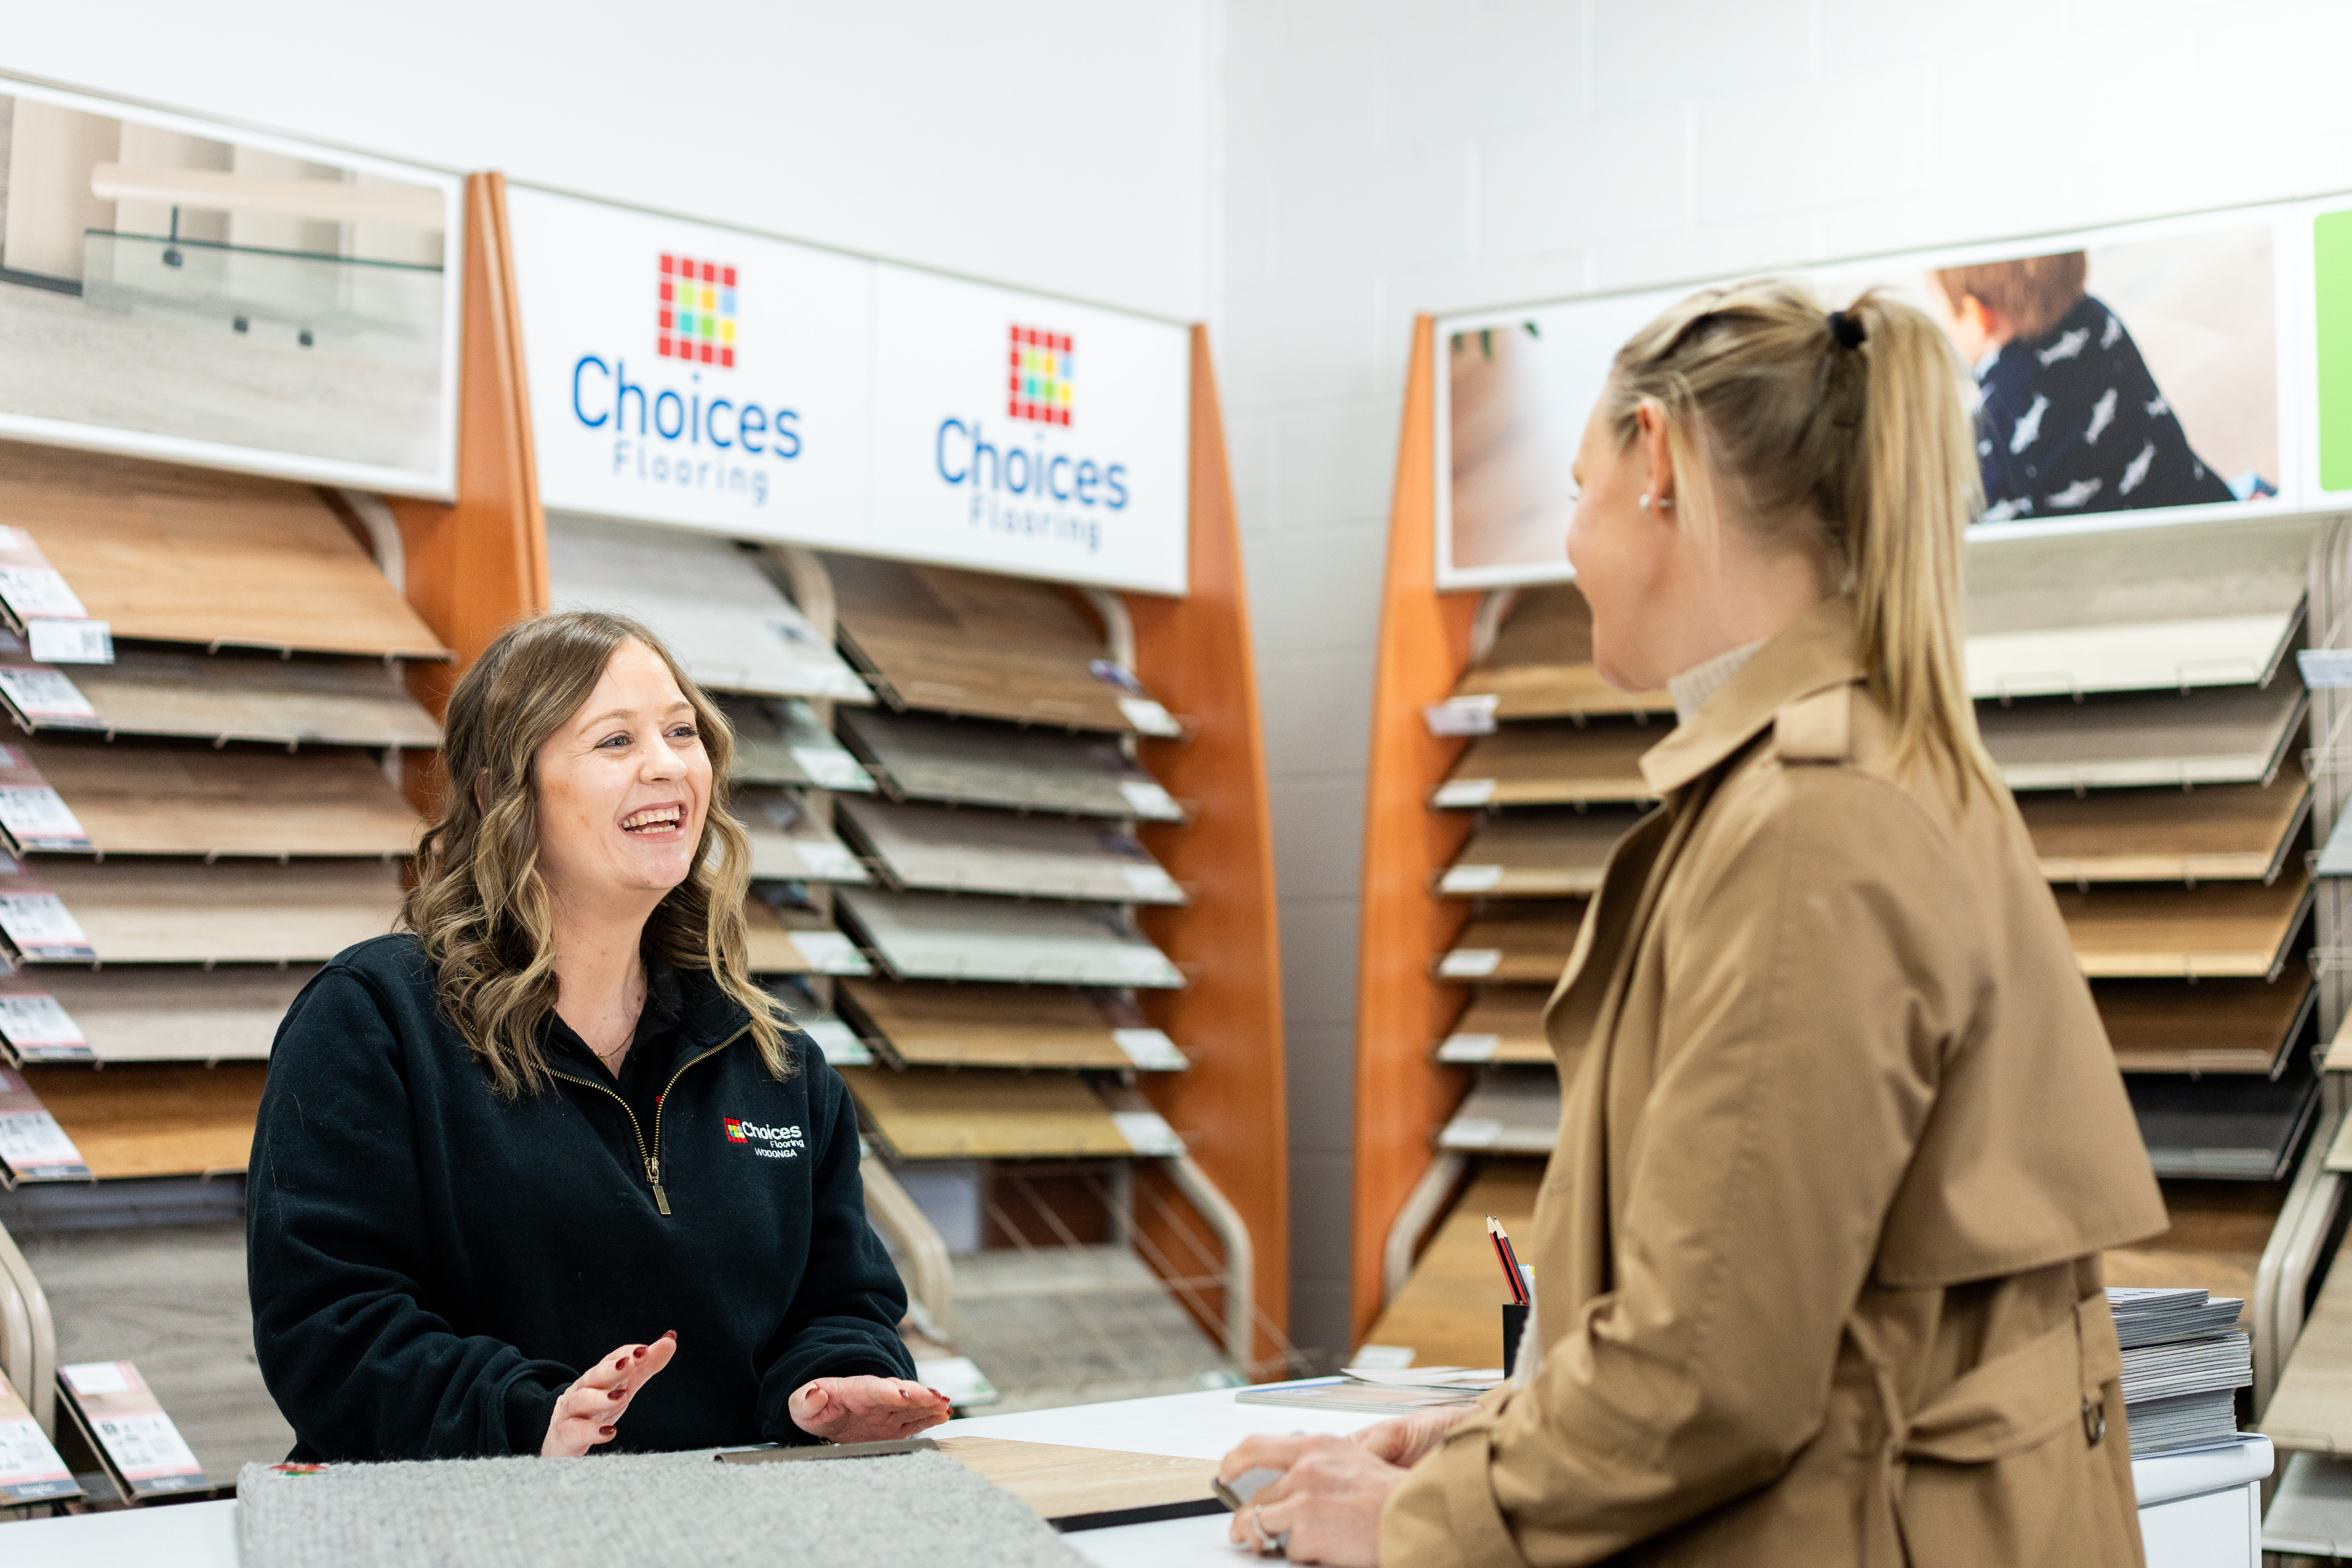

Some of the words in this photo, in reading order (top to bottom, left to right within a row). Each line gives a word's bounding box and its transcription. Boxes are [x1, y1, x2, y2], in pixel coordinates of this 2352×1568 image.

[572, 353, 802, 461] Choices
[614, 440, 769, 507] Flooring
[937, 417, 1128, 511] Choices
[970, 495, 1101, 553] Flooring
[742, 1121, 802, 1140] Choices
[755, 1147, 797, 1158] WODONGA
[770, 1139, 804, 1149] Flooring
